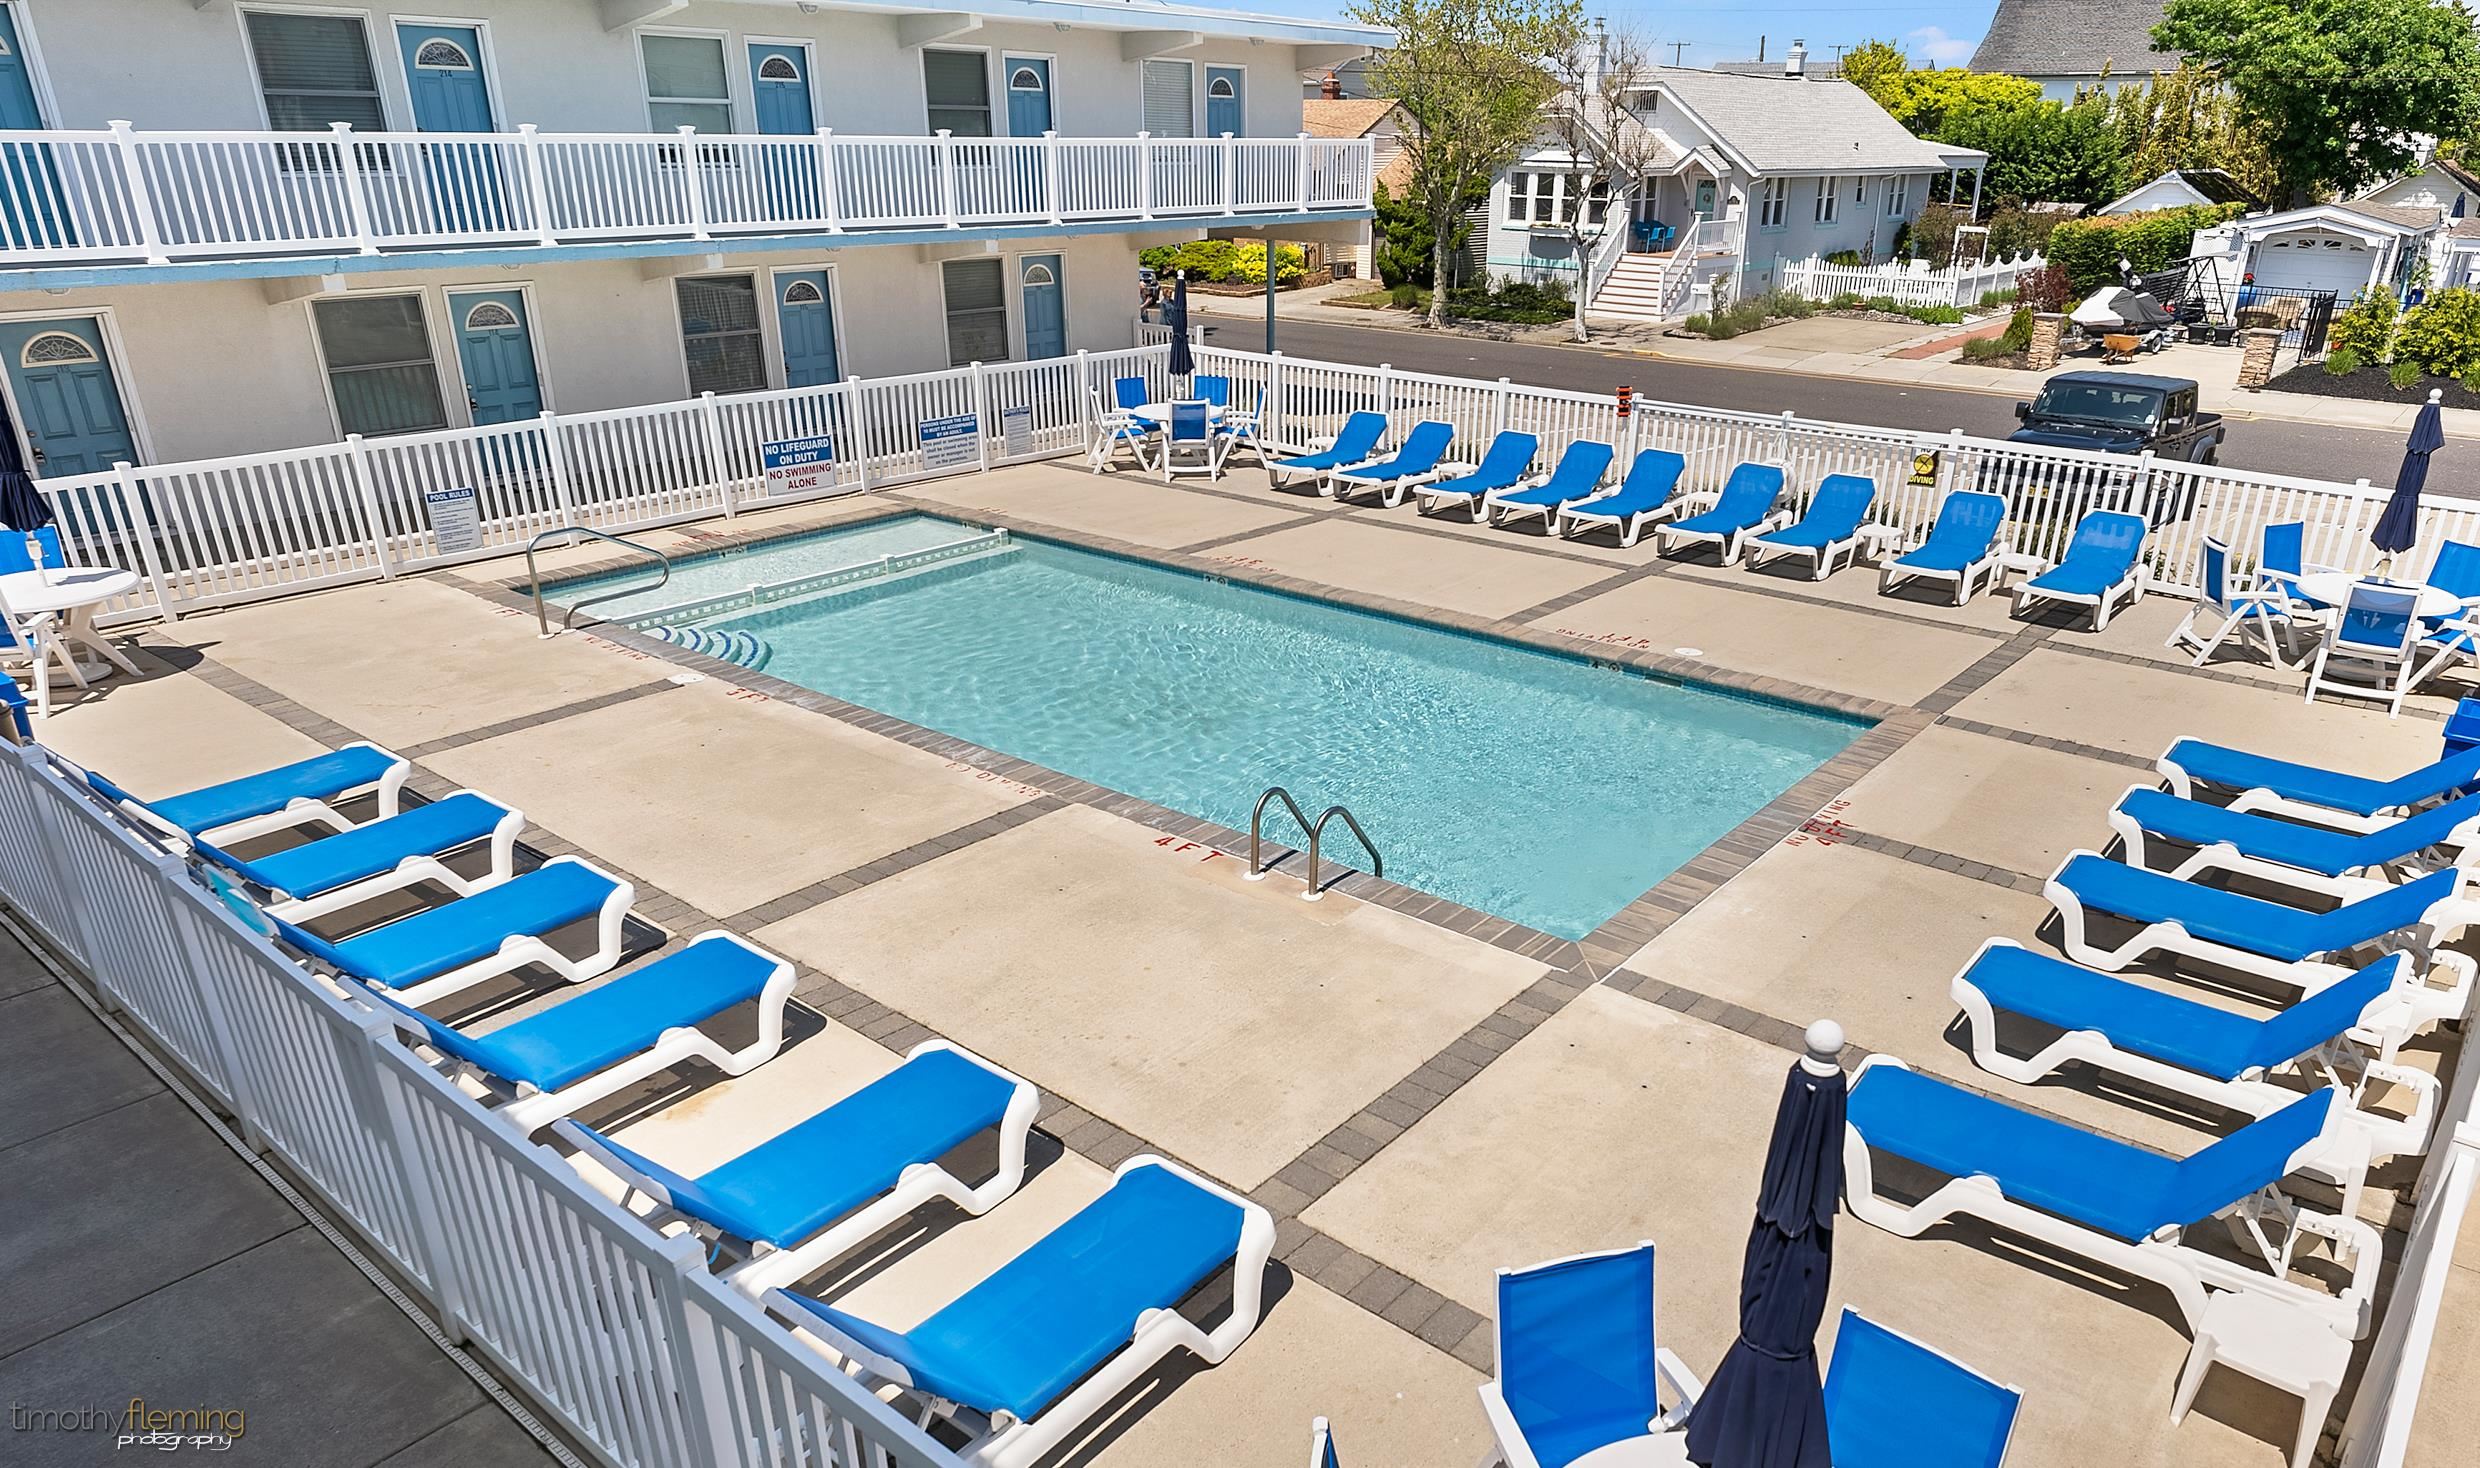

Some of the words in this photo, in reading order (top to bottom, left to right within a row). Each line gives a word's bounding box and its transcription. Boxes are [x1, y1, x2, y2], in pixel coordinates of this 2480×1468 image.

[765, 445, 779, 455] NO
[780, 438, 829, 453] LIFEGUARD
[780, 455, 793, 465] ON
[795, 451, 818, 463] DUTY
[769, 470, 783, 480] NO
[785, 463, 831, 478] SWIMMING
[788, 477, 817, 489] ALONE
[1910, 476, 1934, 485] DIVING
[449, 490, 470, 498] RULES
[1785, 835, 1809, 847] NO
